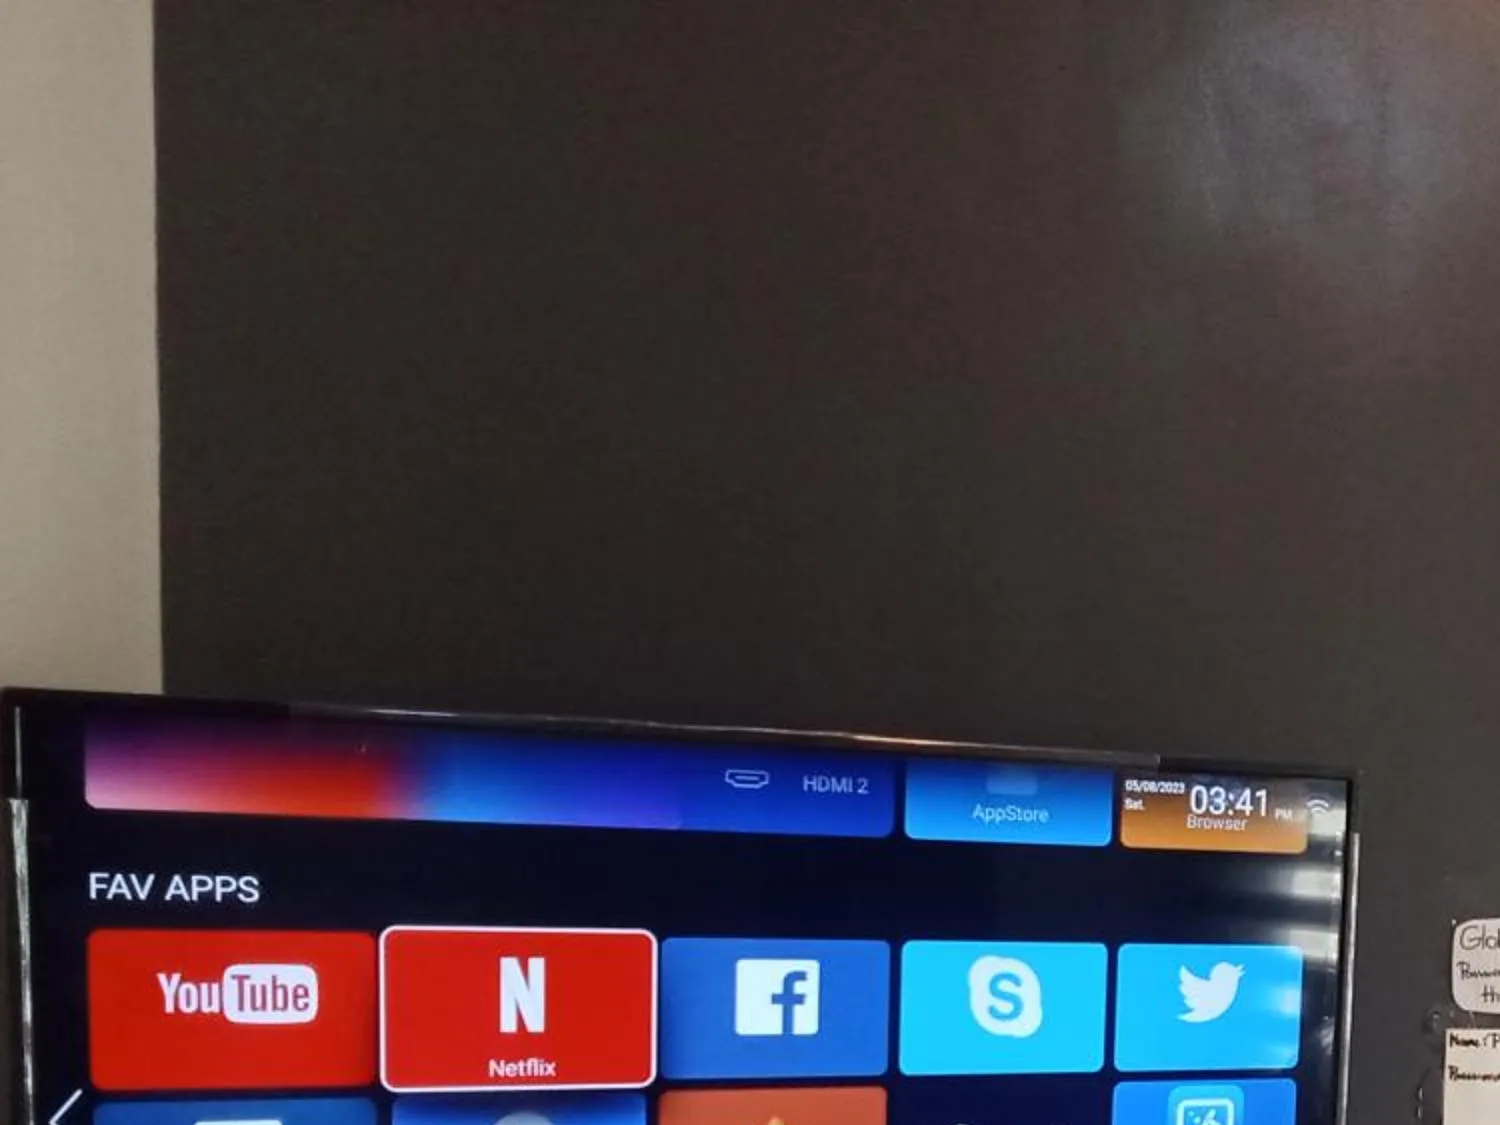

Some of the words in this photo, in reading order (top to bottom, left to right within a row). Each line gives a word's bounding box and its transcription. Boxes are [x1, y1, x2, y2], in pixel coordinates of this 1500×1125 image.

[803, 775, 853, 794] HDMI
[857, 777, 870, 795] 2
[972, 803, 1049, 825] AppStore
[1190, 784, 1269, 817] 03:41
[1274, 808, 1294, 821] PM
[1186, 814, 1248, 831] Browser
[89, 872, 155, 900] FAV
[164, 874, 260, 903] APPS
[156, 971, 311, 1014] YouTube
[499, 956, 546, 1033] N
[488, 1057, 557, 1078] Netflix
